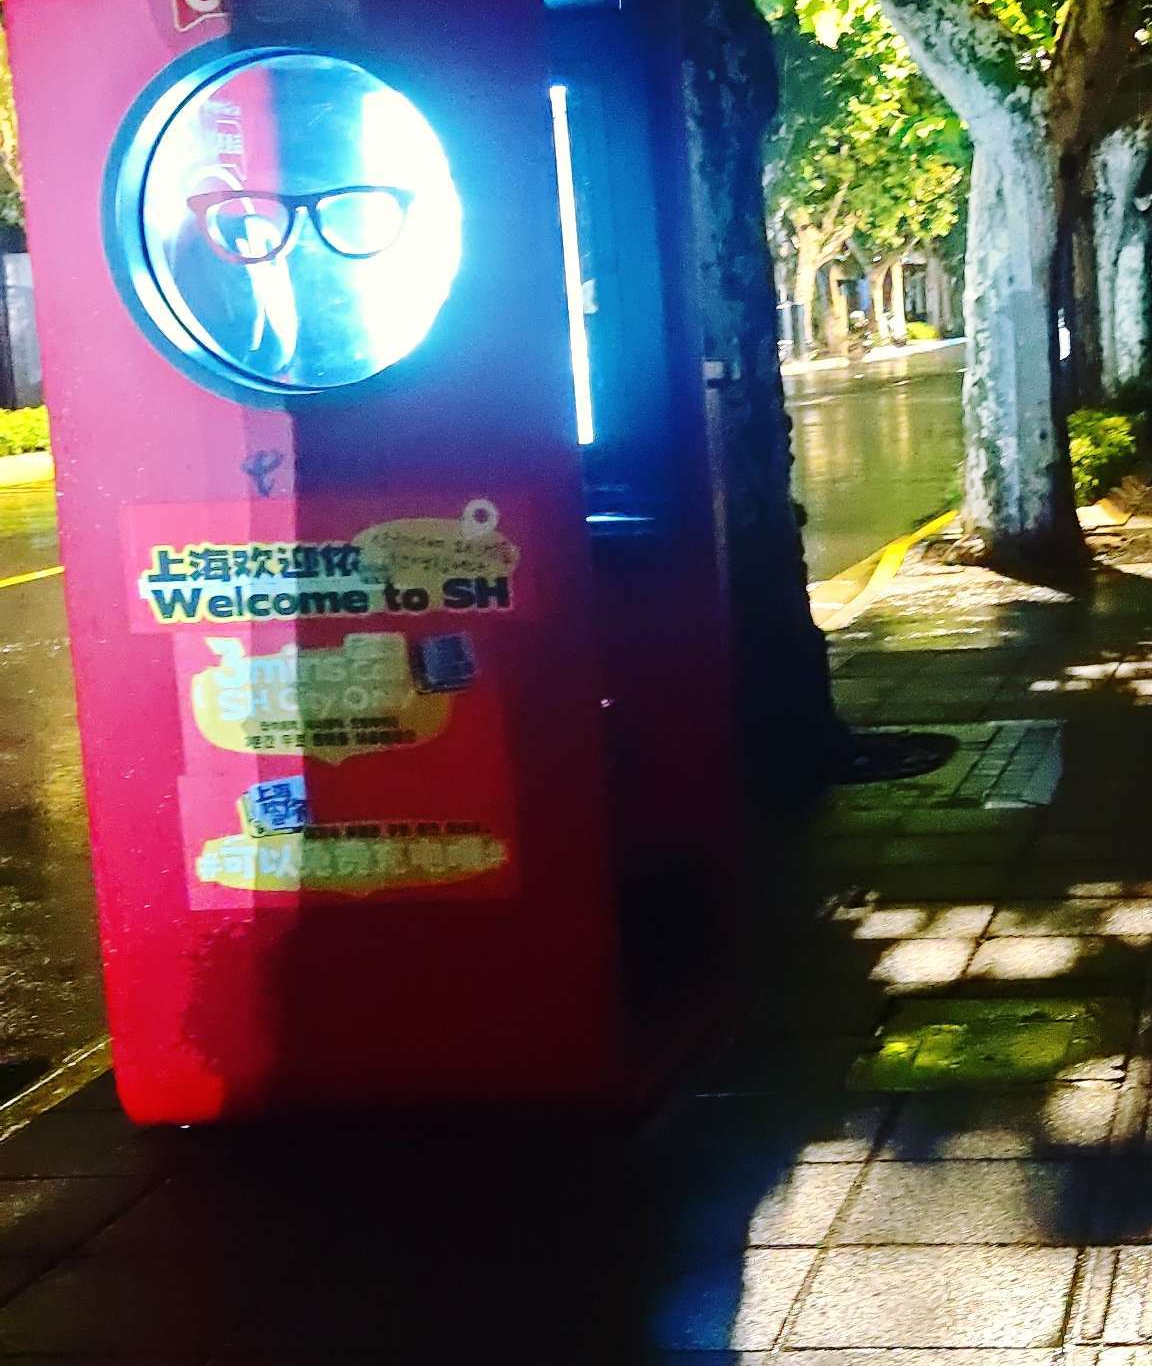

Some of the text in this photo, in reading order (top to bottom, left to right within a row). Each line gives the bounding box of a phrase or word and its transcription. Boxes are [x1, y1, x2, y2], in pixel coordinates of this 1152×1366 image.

[151, 575, 511, 619] Welcome to SH
